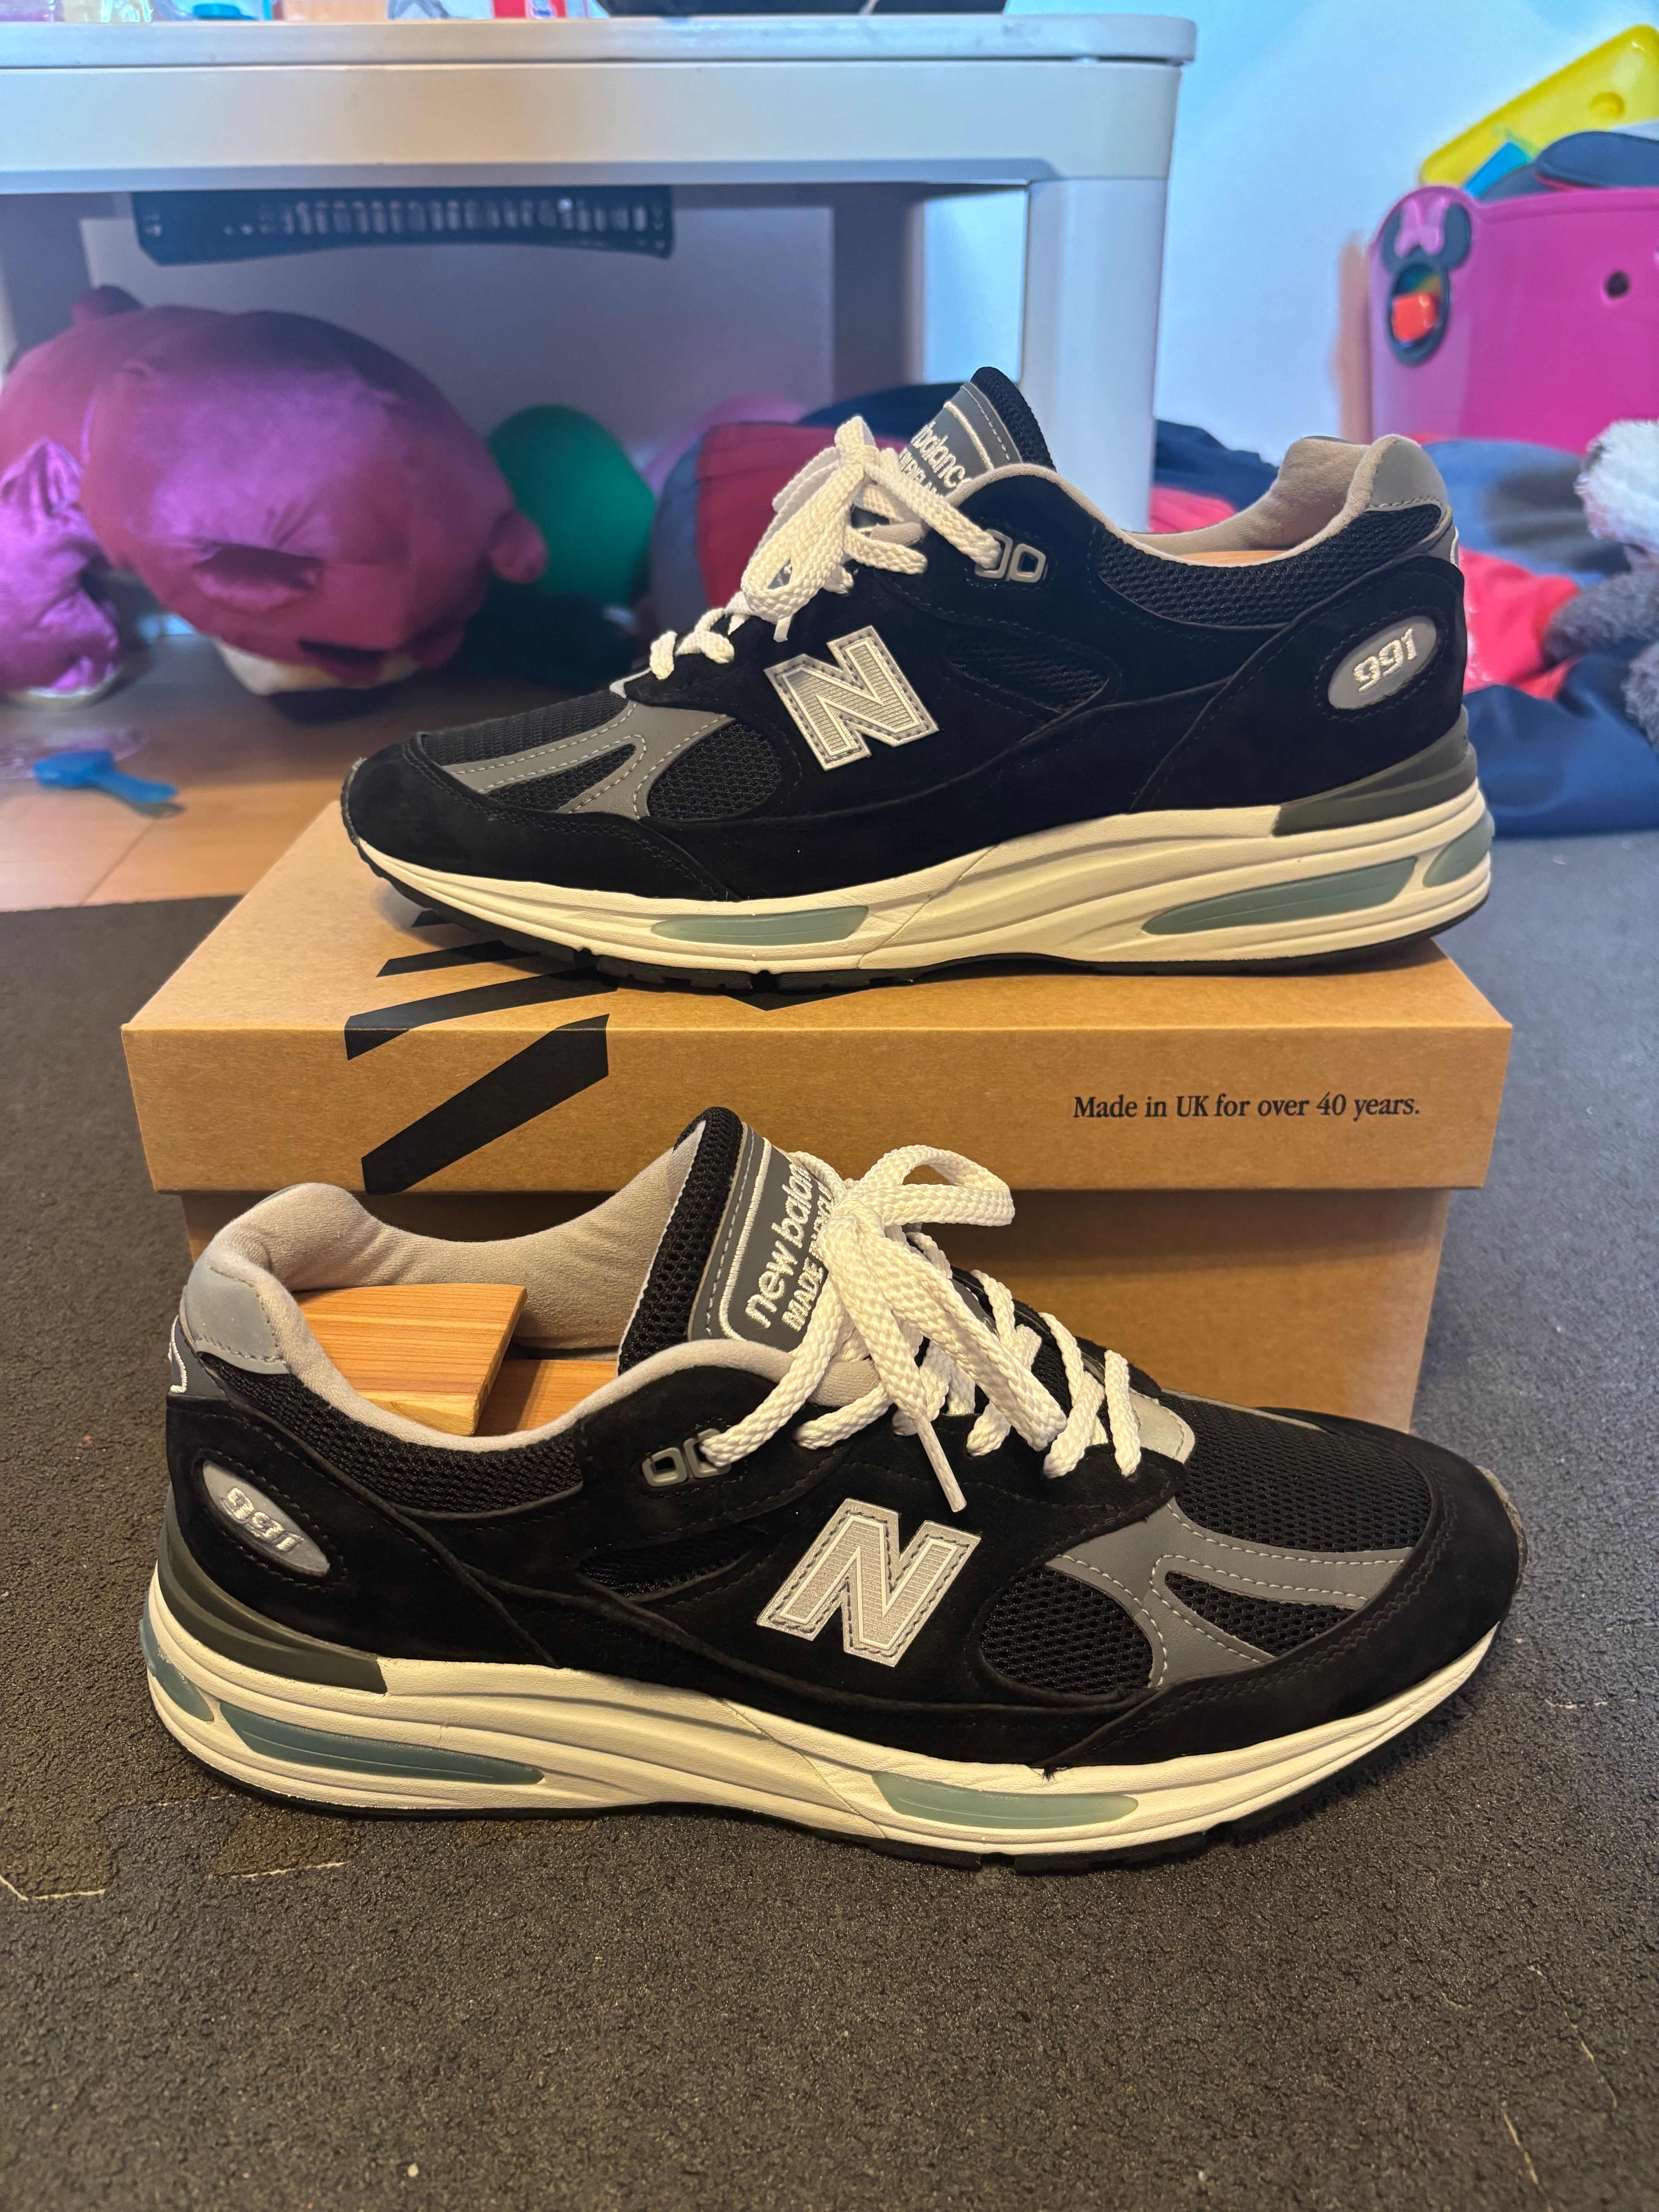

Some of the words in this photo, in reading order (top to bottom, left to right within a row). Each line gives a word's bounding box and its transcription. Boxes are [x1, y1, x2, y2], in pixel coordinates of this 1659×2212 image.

[1353, 628, 1417, 692] 991
[763, 625, 939, 771] N
[1073, 1094, 1137, 1118] Made
[1144, 1096, 1167, 1117] in
[1176, 1096, 1209, 1117] UK
[1214, 1093, 1250, 1116] for
[1257, 1099, 1309, 1116] over
[1316, 1091, 1346, 1116] 40
[1353, 1097, 1420, 1122] years.
[745, 1240, 798, 1328] new
[781, 1257, 824, 1331] MADE
[221, 1486, 304, 1550] 991
[756, 1498, 981, 1667] N
